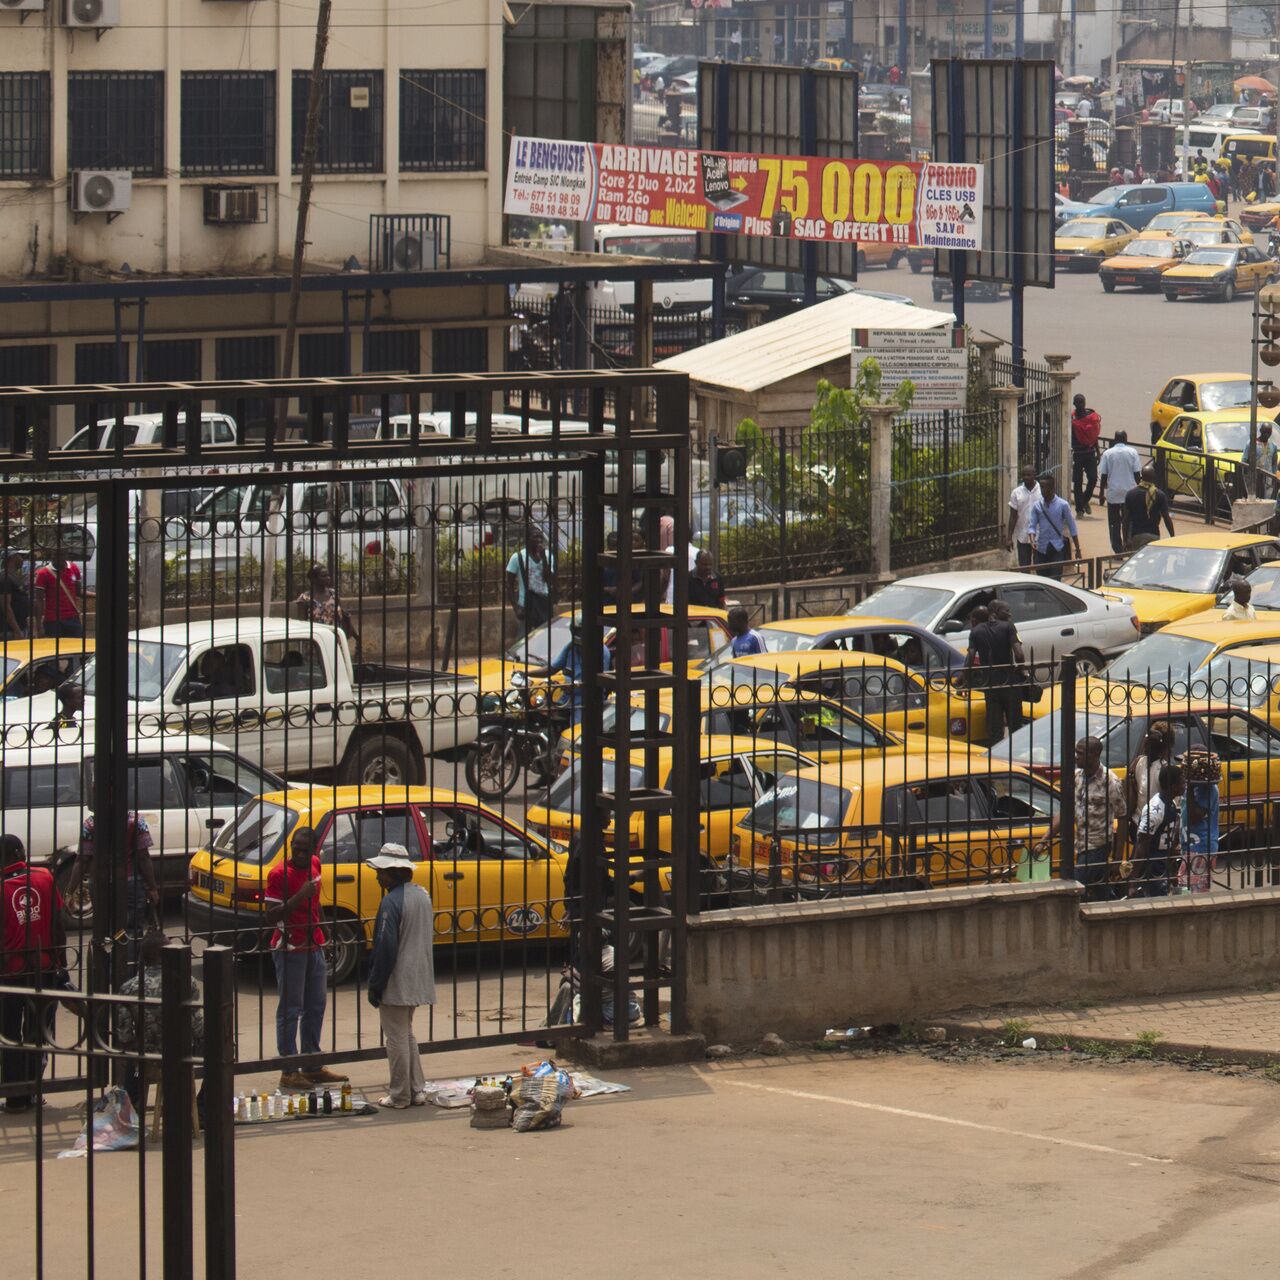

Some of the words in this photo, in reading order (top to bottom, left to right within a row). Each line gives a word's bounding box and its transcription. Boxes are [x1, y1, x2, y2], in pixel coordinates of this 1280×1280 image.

[515, 140, 528, 168] LE
[529, 141, 586, 173] BENGUISTE
[600, 145, 698, 177] ARRIVAGE
[702, 154, 715, 168] Dell
[749, 156, 757, 174] de
[514, 171, 532, 184] Entrée
[532, 173, 548, 187] Camp
[549, 175, 560, 186] SIC
[706, 167, 723, 180] Acer
[927, 165, 977, 188] PROMO
[599, 172, 625, 188] Core
[627, 174, 635, 189] 2
[637, 175, 659, 191] Duo
[664, 176, 696, 194] 2.0x2
[704, 180, 729, 192] Lenovo
[531, 190, 546, 202] 677
[547, 192, 556, 203] 51
[559, 193, 569, 204] 98
[570, 194, 581, 205] 09
[598, 188, 624, 203] Ram
[626, 190, 650, 205] 2Go
[758, 158, 809, 221] 75
[821, 160, 915, 226] 000
[926, 189, 952, 201] CLES
[955, 191, 976, 202] USB
[529, 203, 544, 214] 694
[547, 204, 555, 216] 18
[557, 205, 567, 217] 48
[569, 206, 579, 218] 34
[597, 203, 612, 220] DD
[615, 205, 633, 222] 120
[634, 206, 649, 224] Go
[649, 208, 665, 225] avec
[665, 197, 707, 229] Webcam
[744, 215, 772, 236] Plus
[778, 220, 785, 235] 1
[794, 218, 826, 238] SAC
[832, 220, 890, 242] OFFERT
[892, 223, 909, 243] !!!
[956, 224, 965, 234] et
[924, 234, 976, 249] Maintenance
